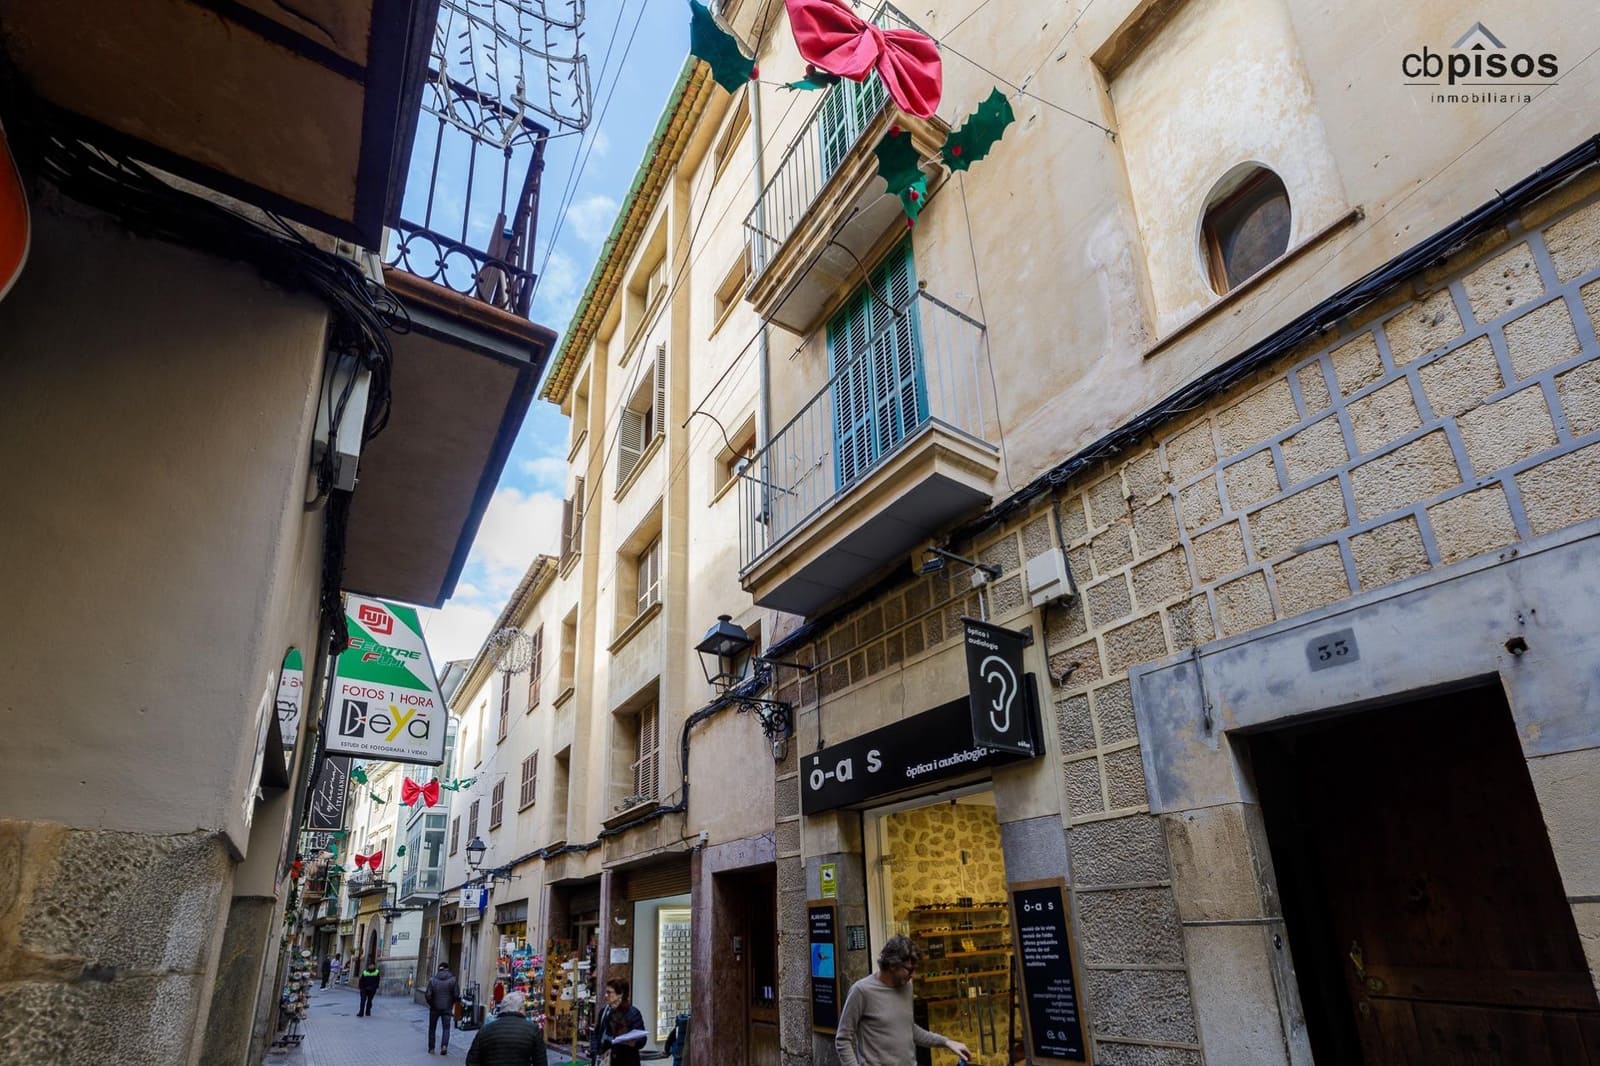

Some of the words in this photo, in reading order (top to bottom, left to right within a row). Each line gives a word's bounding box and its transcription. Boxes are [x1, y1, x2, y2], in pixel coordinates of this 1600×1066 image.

[347, 637, 422, 660] CENTRE
[1318, 640, 1349, 662] 33
[342, 684, 385, 701] FOTOS
[390, 692, 395, 703] 1
[400, 694, 434, 708] HORA
[866, 750, 882, 774] s
[906, 762, 933, 779] òptica
[933, 759, 937, 770] i
[938, 747, 988, 769] audiologia
[336, 775, 346, 807] ITALIANO
[1047, 902, 1054, 910] s
